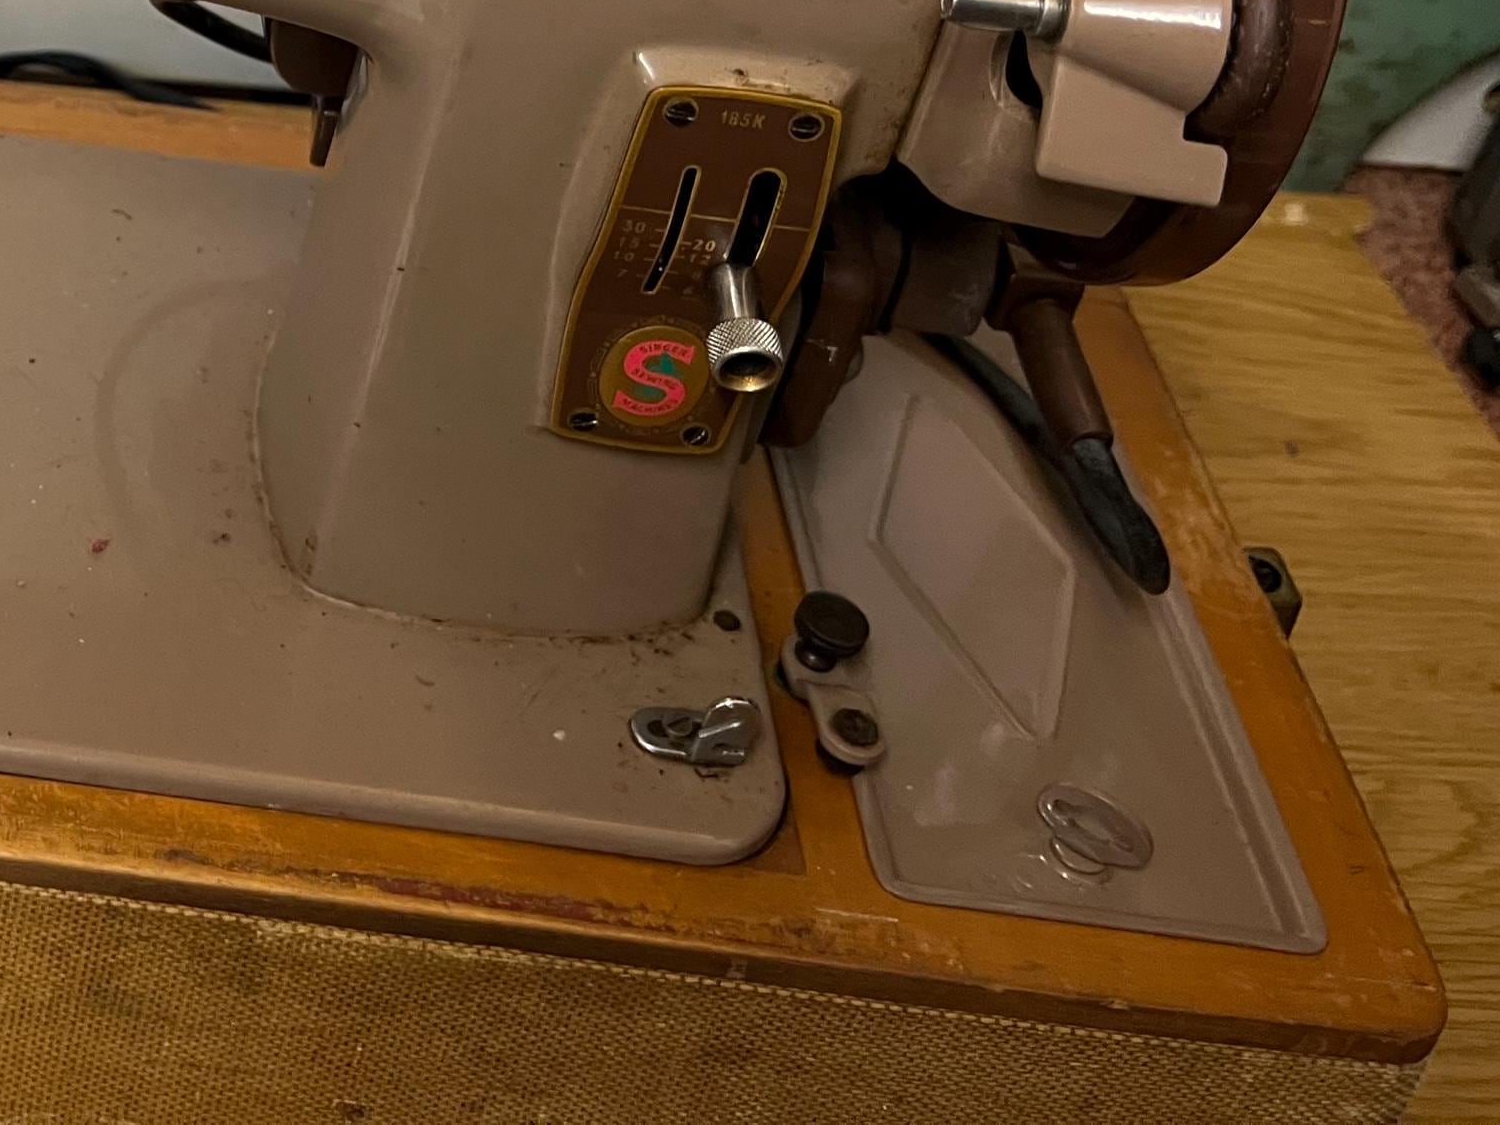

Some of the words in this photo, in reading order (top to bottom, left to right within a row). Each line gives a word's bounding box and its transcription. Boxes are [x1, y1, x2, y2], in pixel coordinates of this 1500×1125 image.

[720, 108, 768, 130] 185K
[621, 219, 647, 234] 30
[691, 238, 717, 253] 20
